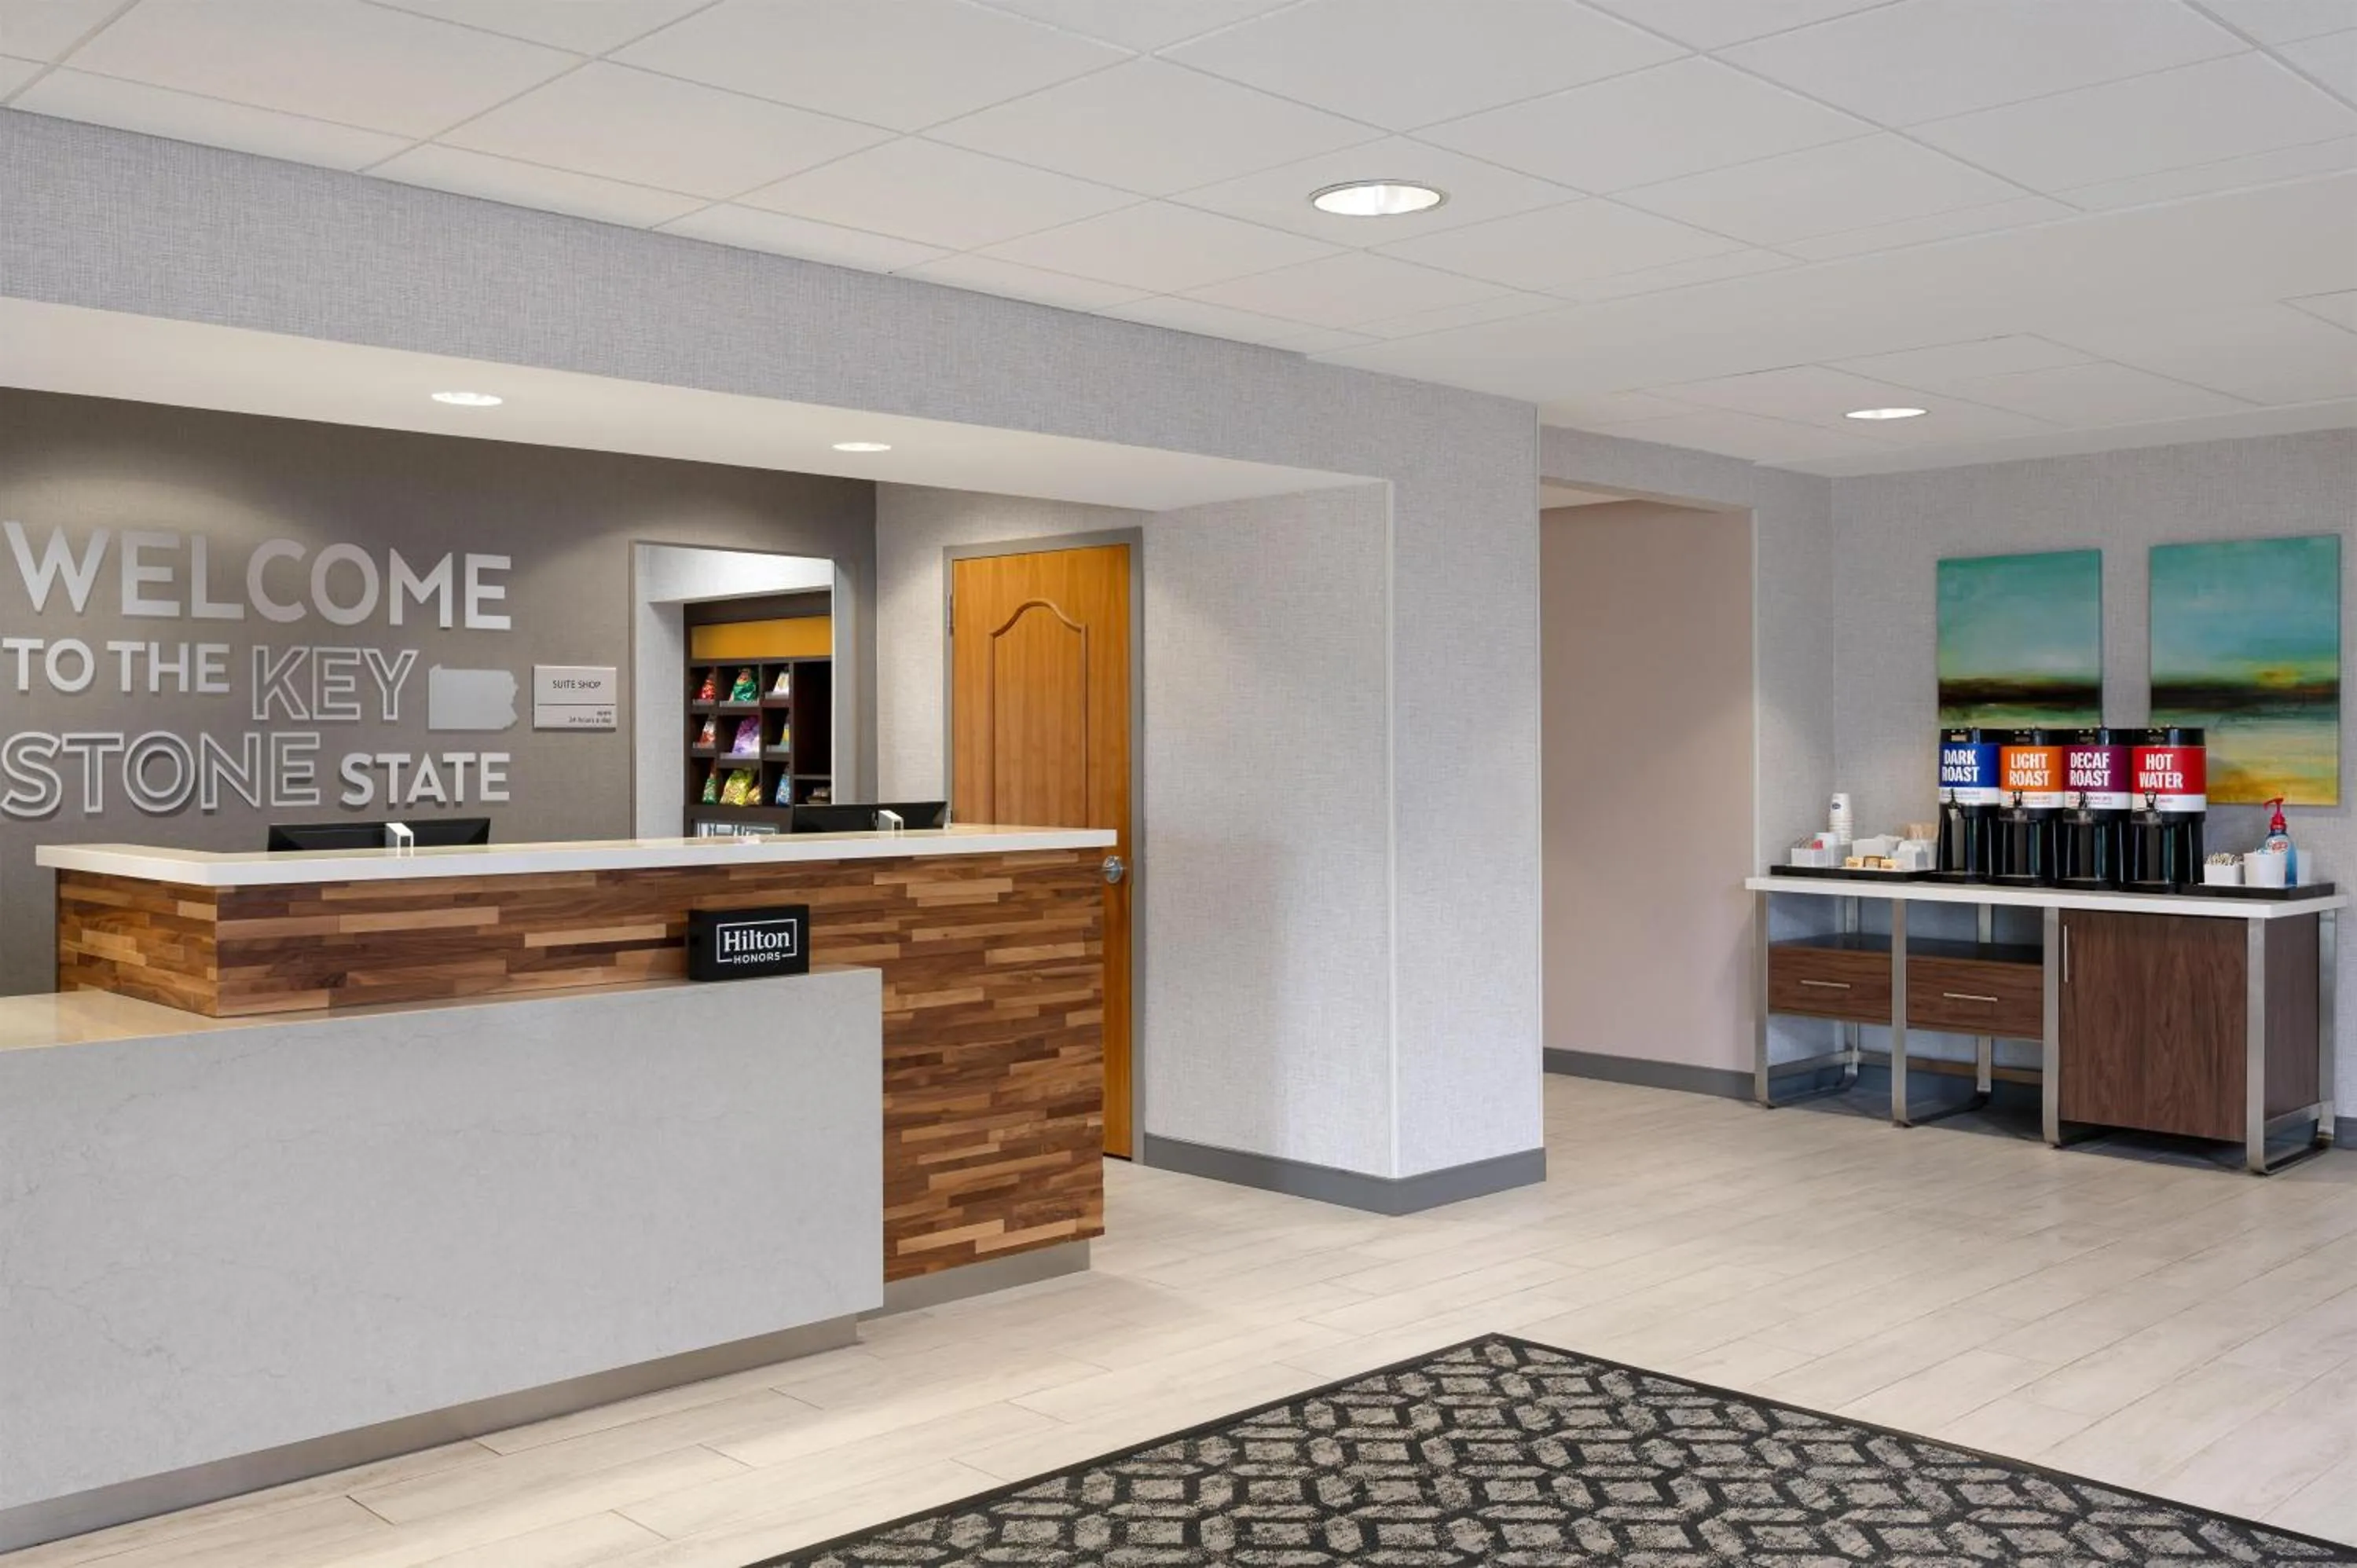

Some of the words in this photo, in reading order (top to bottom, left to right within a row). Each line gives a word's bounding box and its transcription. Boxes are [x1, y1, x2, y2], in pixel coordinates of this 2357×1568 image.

[3, 521, 512, 630] WELCOME
[3, 638, 94, 692] TO
[107, 640, 230, 692] THE
[252, 645, 420, 720] KEY
[552, 680, 576, 689] SUITE
[577, 680, 601, 689] SHOP
[1944, 749, 1977, 766] DARK
[2011, 752, 2048, 769] LIGHT
[2069, 752, 2110, 769] DECAF
[2145, 753, 2174, 771] HOT
[0, 731, 321, 817] STONE
[339, 752, 511, 807] STATE
[1941, 766, 1981, 782] ROAST
[2009, 770, 2051, 786] ROAST
[2069, 770, 2111, 786] ROAST
[2139, 771, 2183, 789] WATER
[724, 929, 790, 953] Hilton
[733, 951, 781, 965] HONORS
